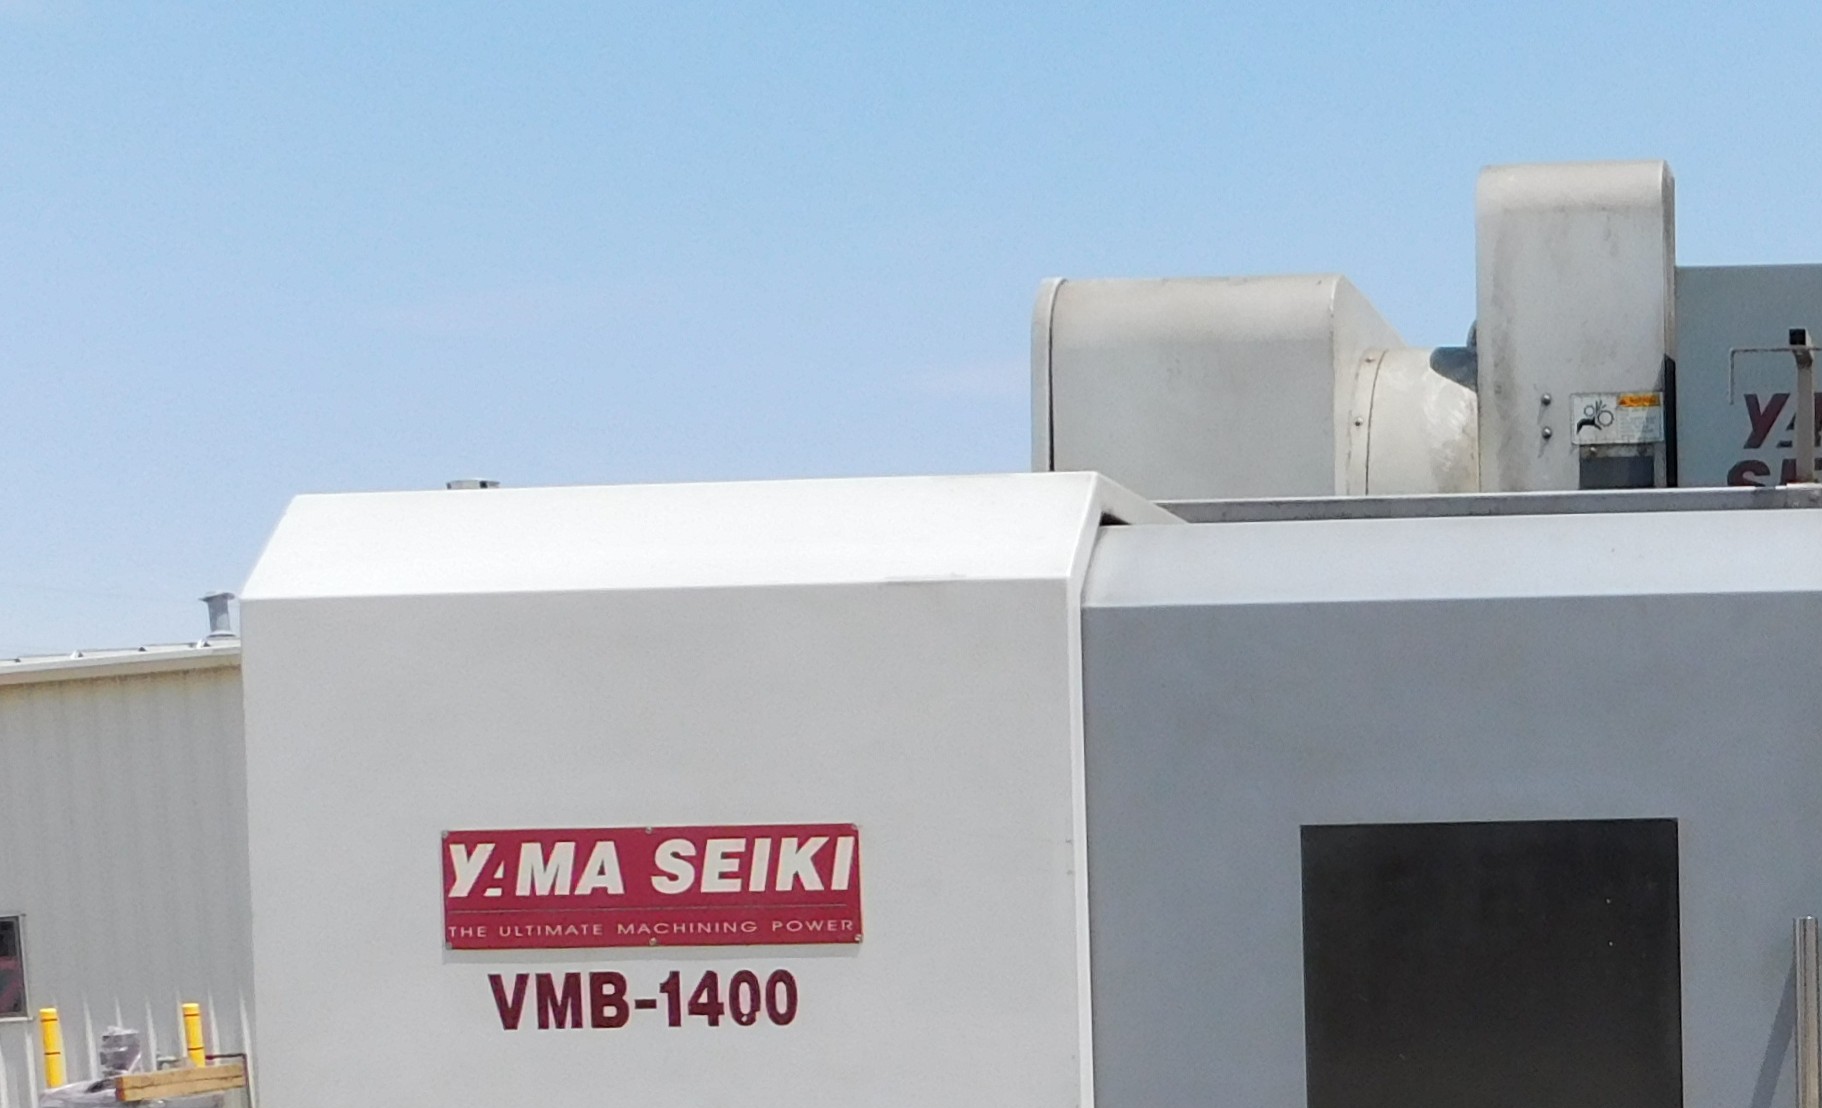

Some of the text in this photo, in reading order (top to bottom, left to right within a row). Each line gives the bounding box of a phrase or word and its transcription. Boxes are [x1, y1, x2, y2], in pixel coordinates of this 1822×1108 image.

[448, 836, 856, 898] YAMA SEIKI
[448, 918, 855, 938] THE ULTIMATE MACHINING POWER
[487, 968, 799, 1031] VMB-1400
